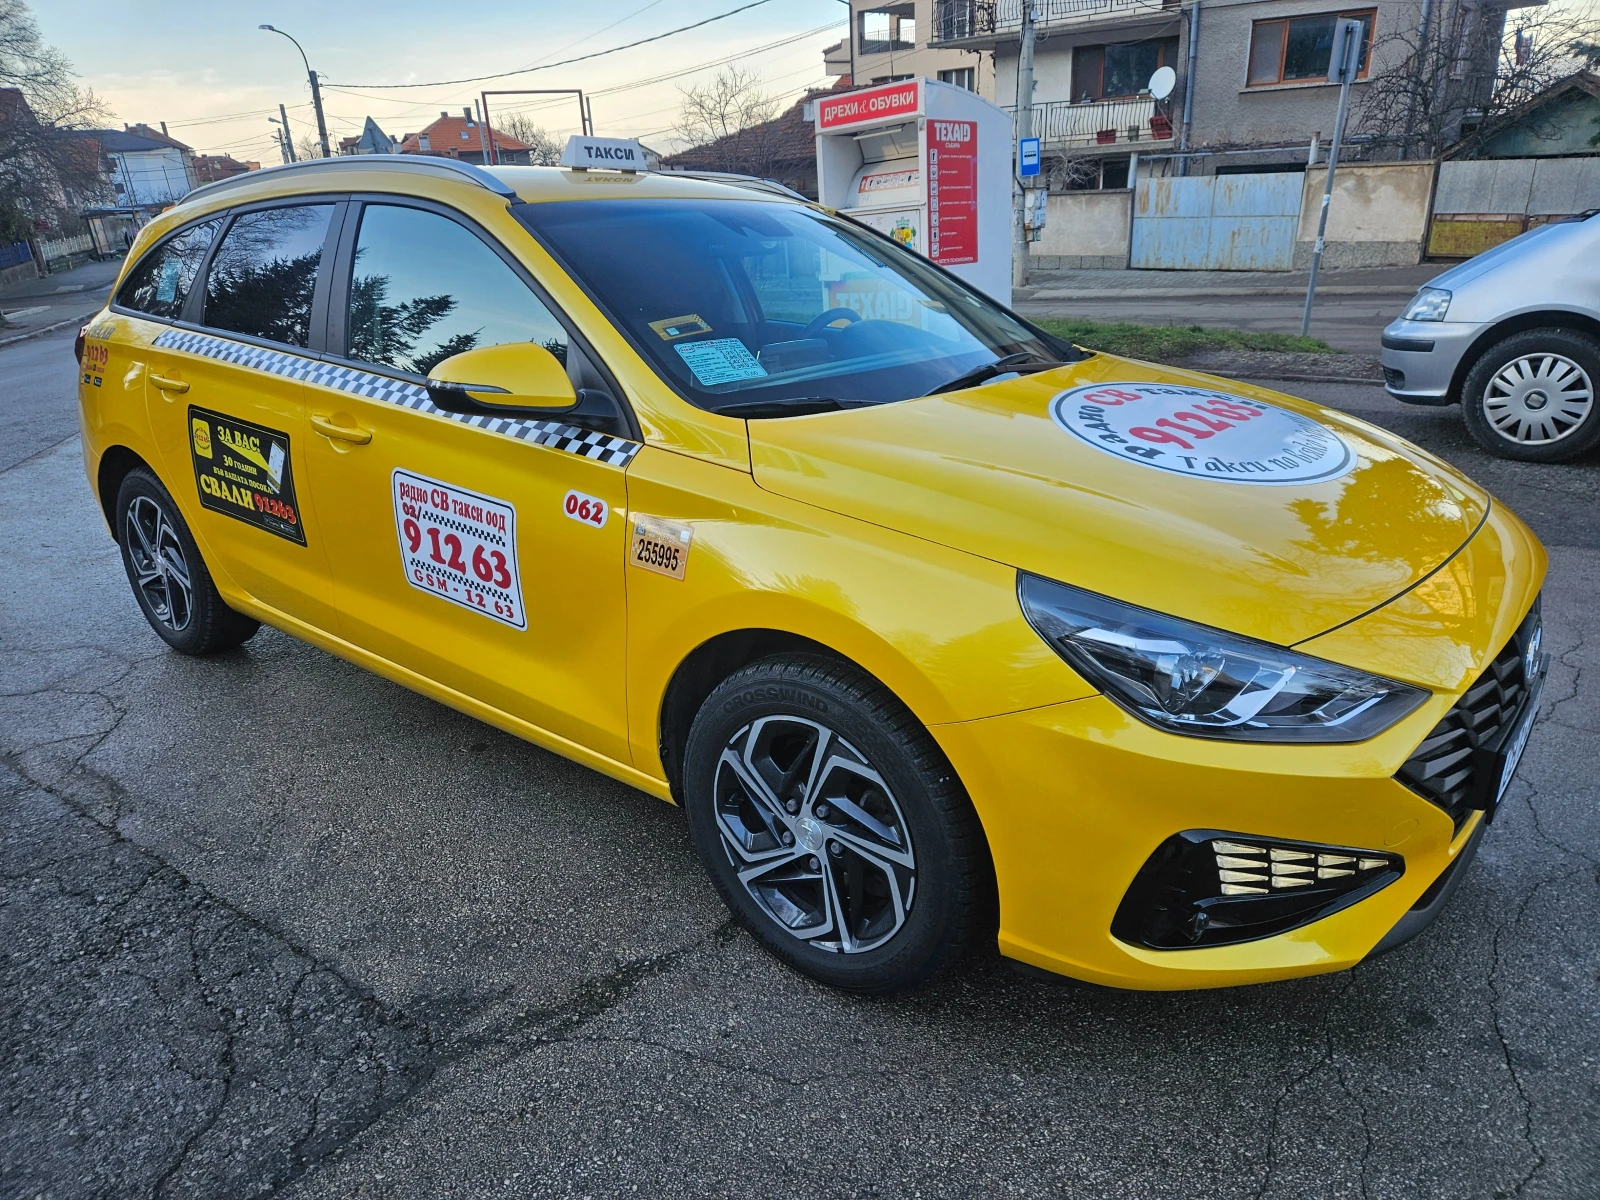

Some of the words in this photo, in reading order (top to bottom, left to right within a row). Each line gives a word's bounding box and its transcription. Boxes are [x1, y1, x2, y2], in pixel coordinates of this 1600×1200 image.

[824, 103, 858, 122] ДРЕХИ
[859, 100, 869, 113] &
[869, 91, 914, 111] ОБУВКИ
[934, 122, 971, 142] TEXAID
[584, 146, 635, 161] ТАКСИ
[836, 291, 913, 320] TEXAID
[217, 425, 233, 447] ЗА
[234, 430, 260, 453] ВАС!
[223, 454, 233, 467] 30
[234, 460, 257, 476] ГОДИНИ
[225, 470, 249, 485] ВАШАТА
[200, 473, 255, 510] СВАЛИ
[253, 493, 297, 524] 91263
[399, 482, 428, 505] радио
[430, 488, 449, 511] СВ
[452, 498, 483, 524] такси
[485, 510, 507, 536] оод
[565, 494, 604, 525] 062
[637, 538, 680, 571] 255995
[723, 687, 829, 713] CROSSWIND
